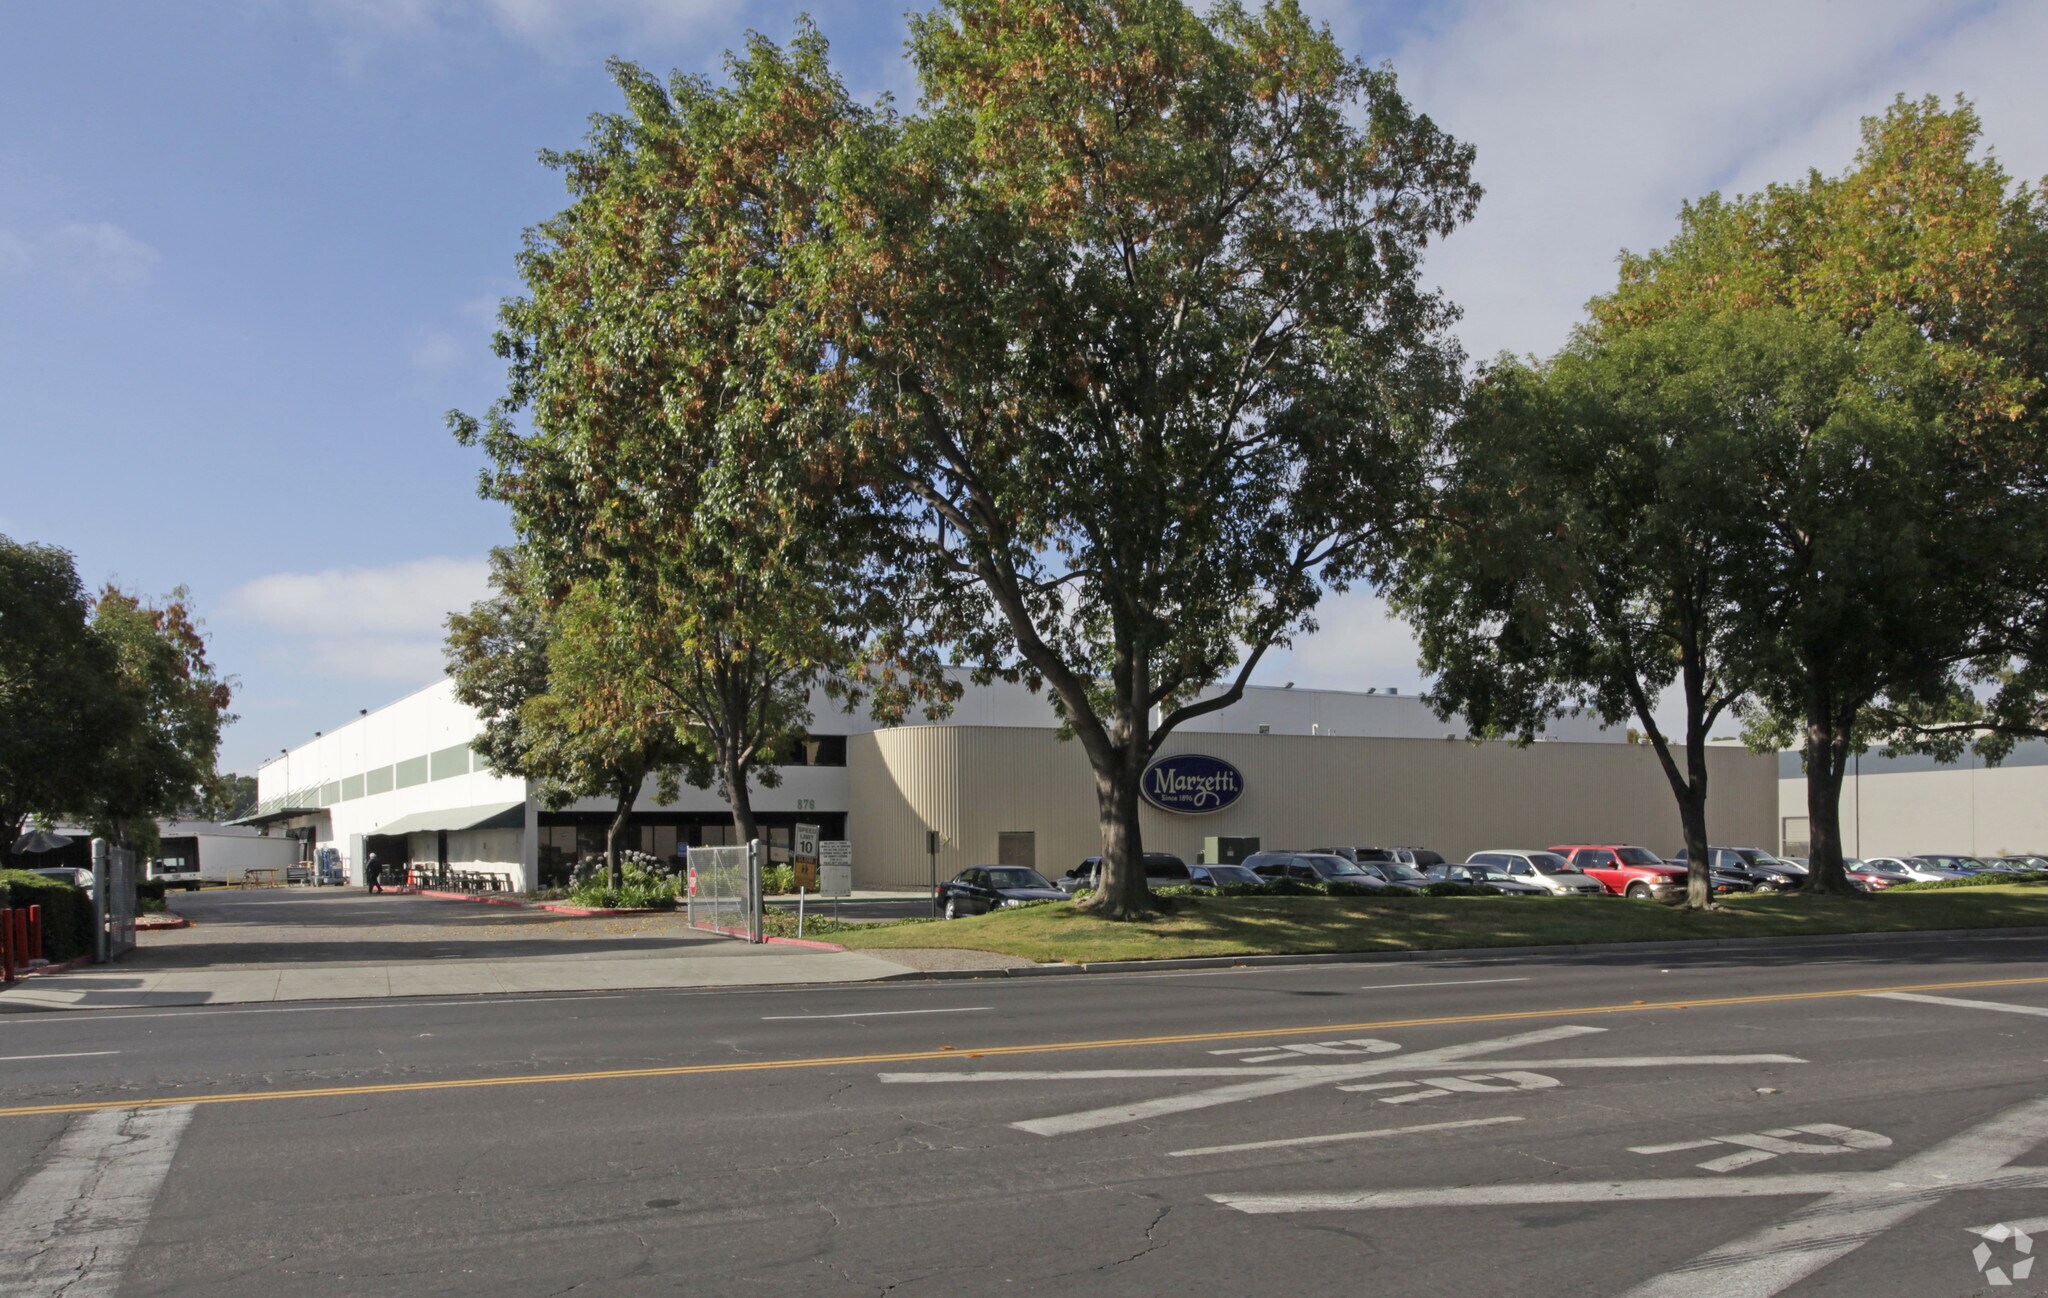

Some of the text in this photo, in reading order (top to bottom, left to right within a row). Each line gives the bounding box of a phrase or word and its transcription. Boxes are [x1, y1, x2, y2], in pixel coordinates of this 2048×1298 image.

[1154, 768, 1234, 807] Marzetti
[1161, 794, 1193, 802] Since 1896
[797, 799, 815, 810] 876
[798, 826, 817, 834] SPEED
[800, 841, 813, 853] 10
